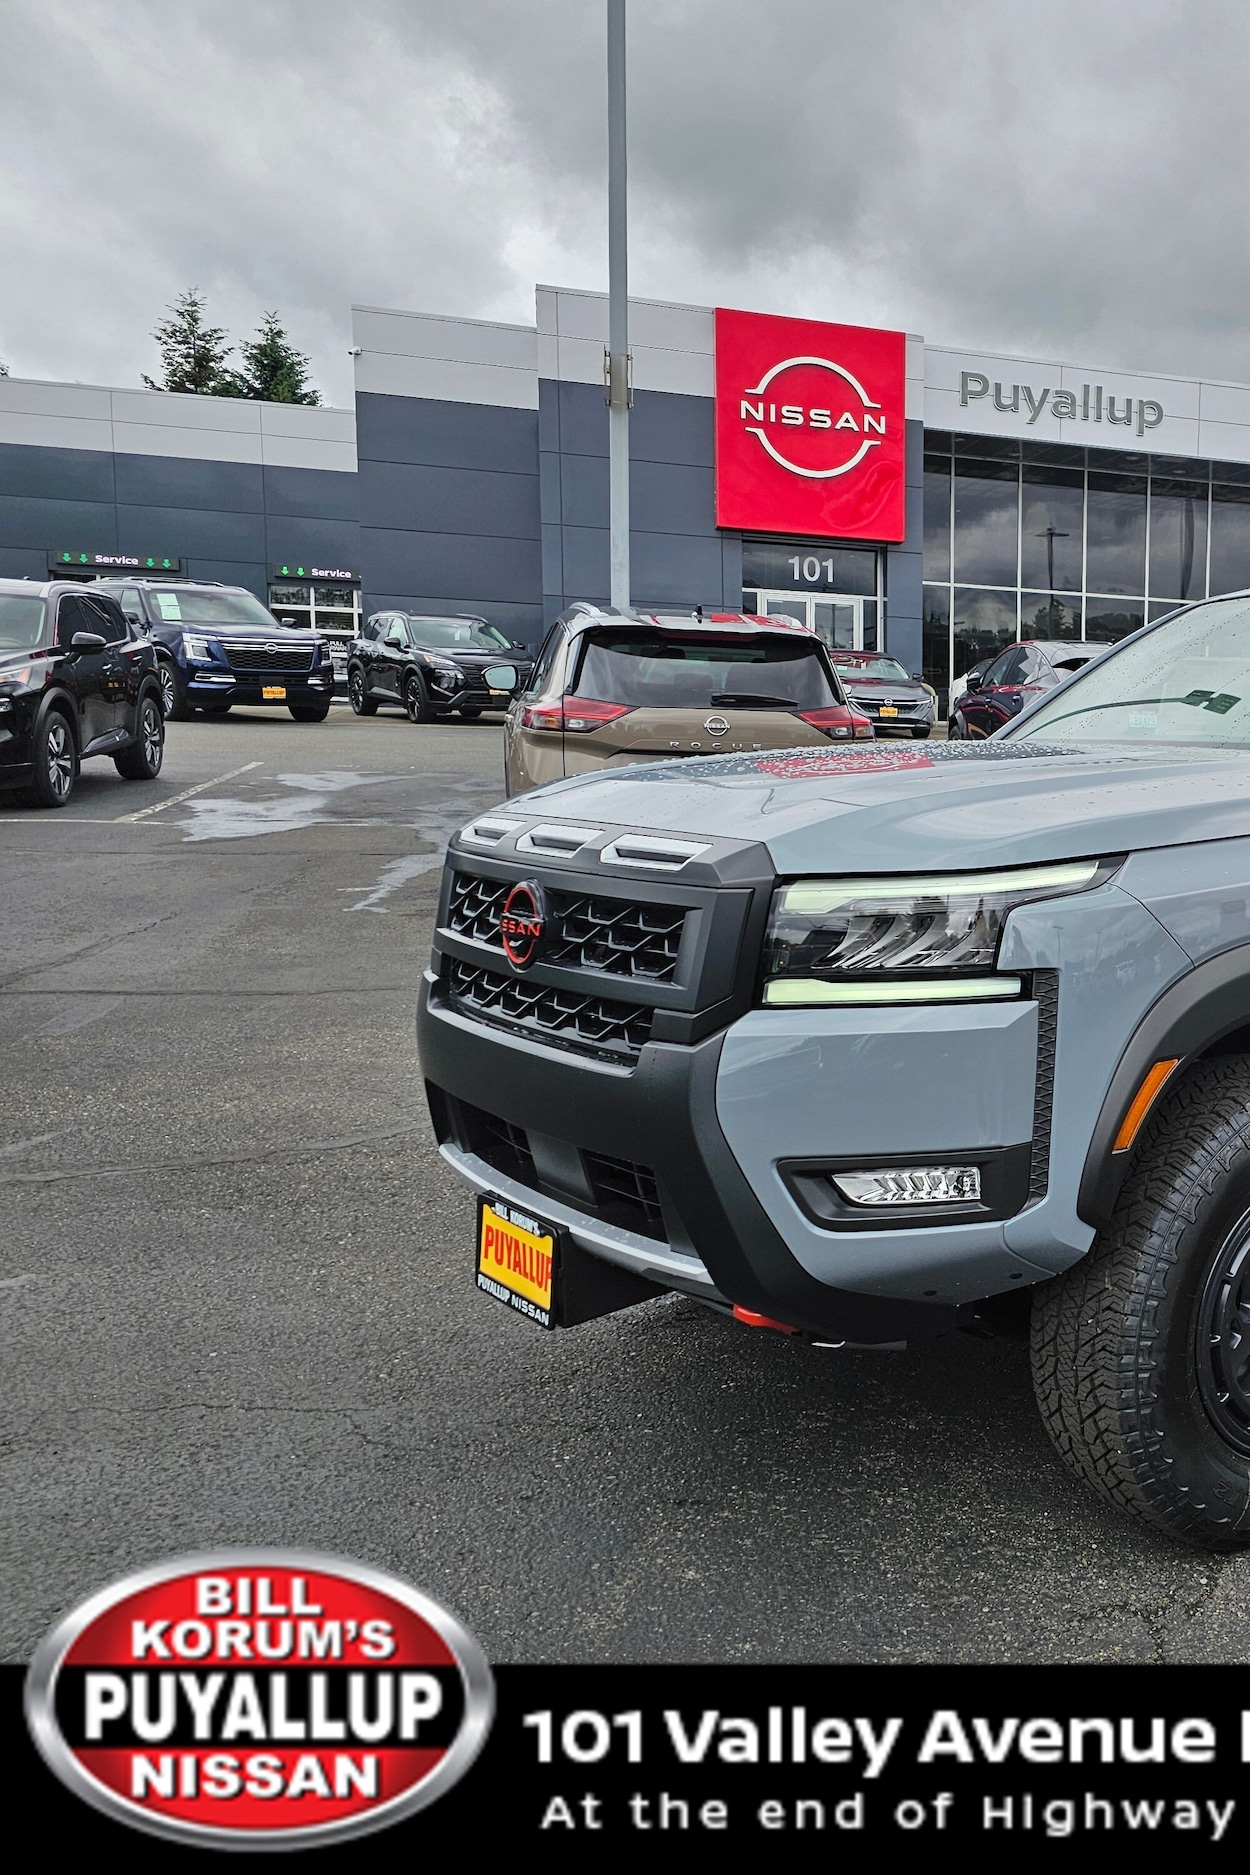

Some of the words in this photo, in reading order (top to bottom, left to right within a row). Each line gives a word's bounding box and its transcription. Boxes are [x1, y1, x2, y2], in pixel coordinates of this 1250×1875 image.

[960, 371, 1164, 436] Puyallup
[740, 400, 887, 435] NISSAN
[95, 554, 139, 566] Service
[311, 568, 352, 579] Service
[788, 556, 835, 583] 101
[669, 741, 762, 751] ROGUE
[501, 918, 541, 937] SSAN
[484, 1224, 552, 1293] PUYALLUP
[477, 1273, 510, 1303] PUYALLUP
[511, 1294, 550, 1326] NISSAN
